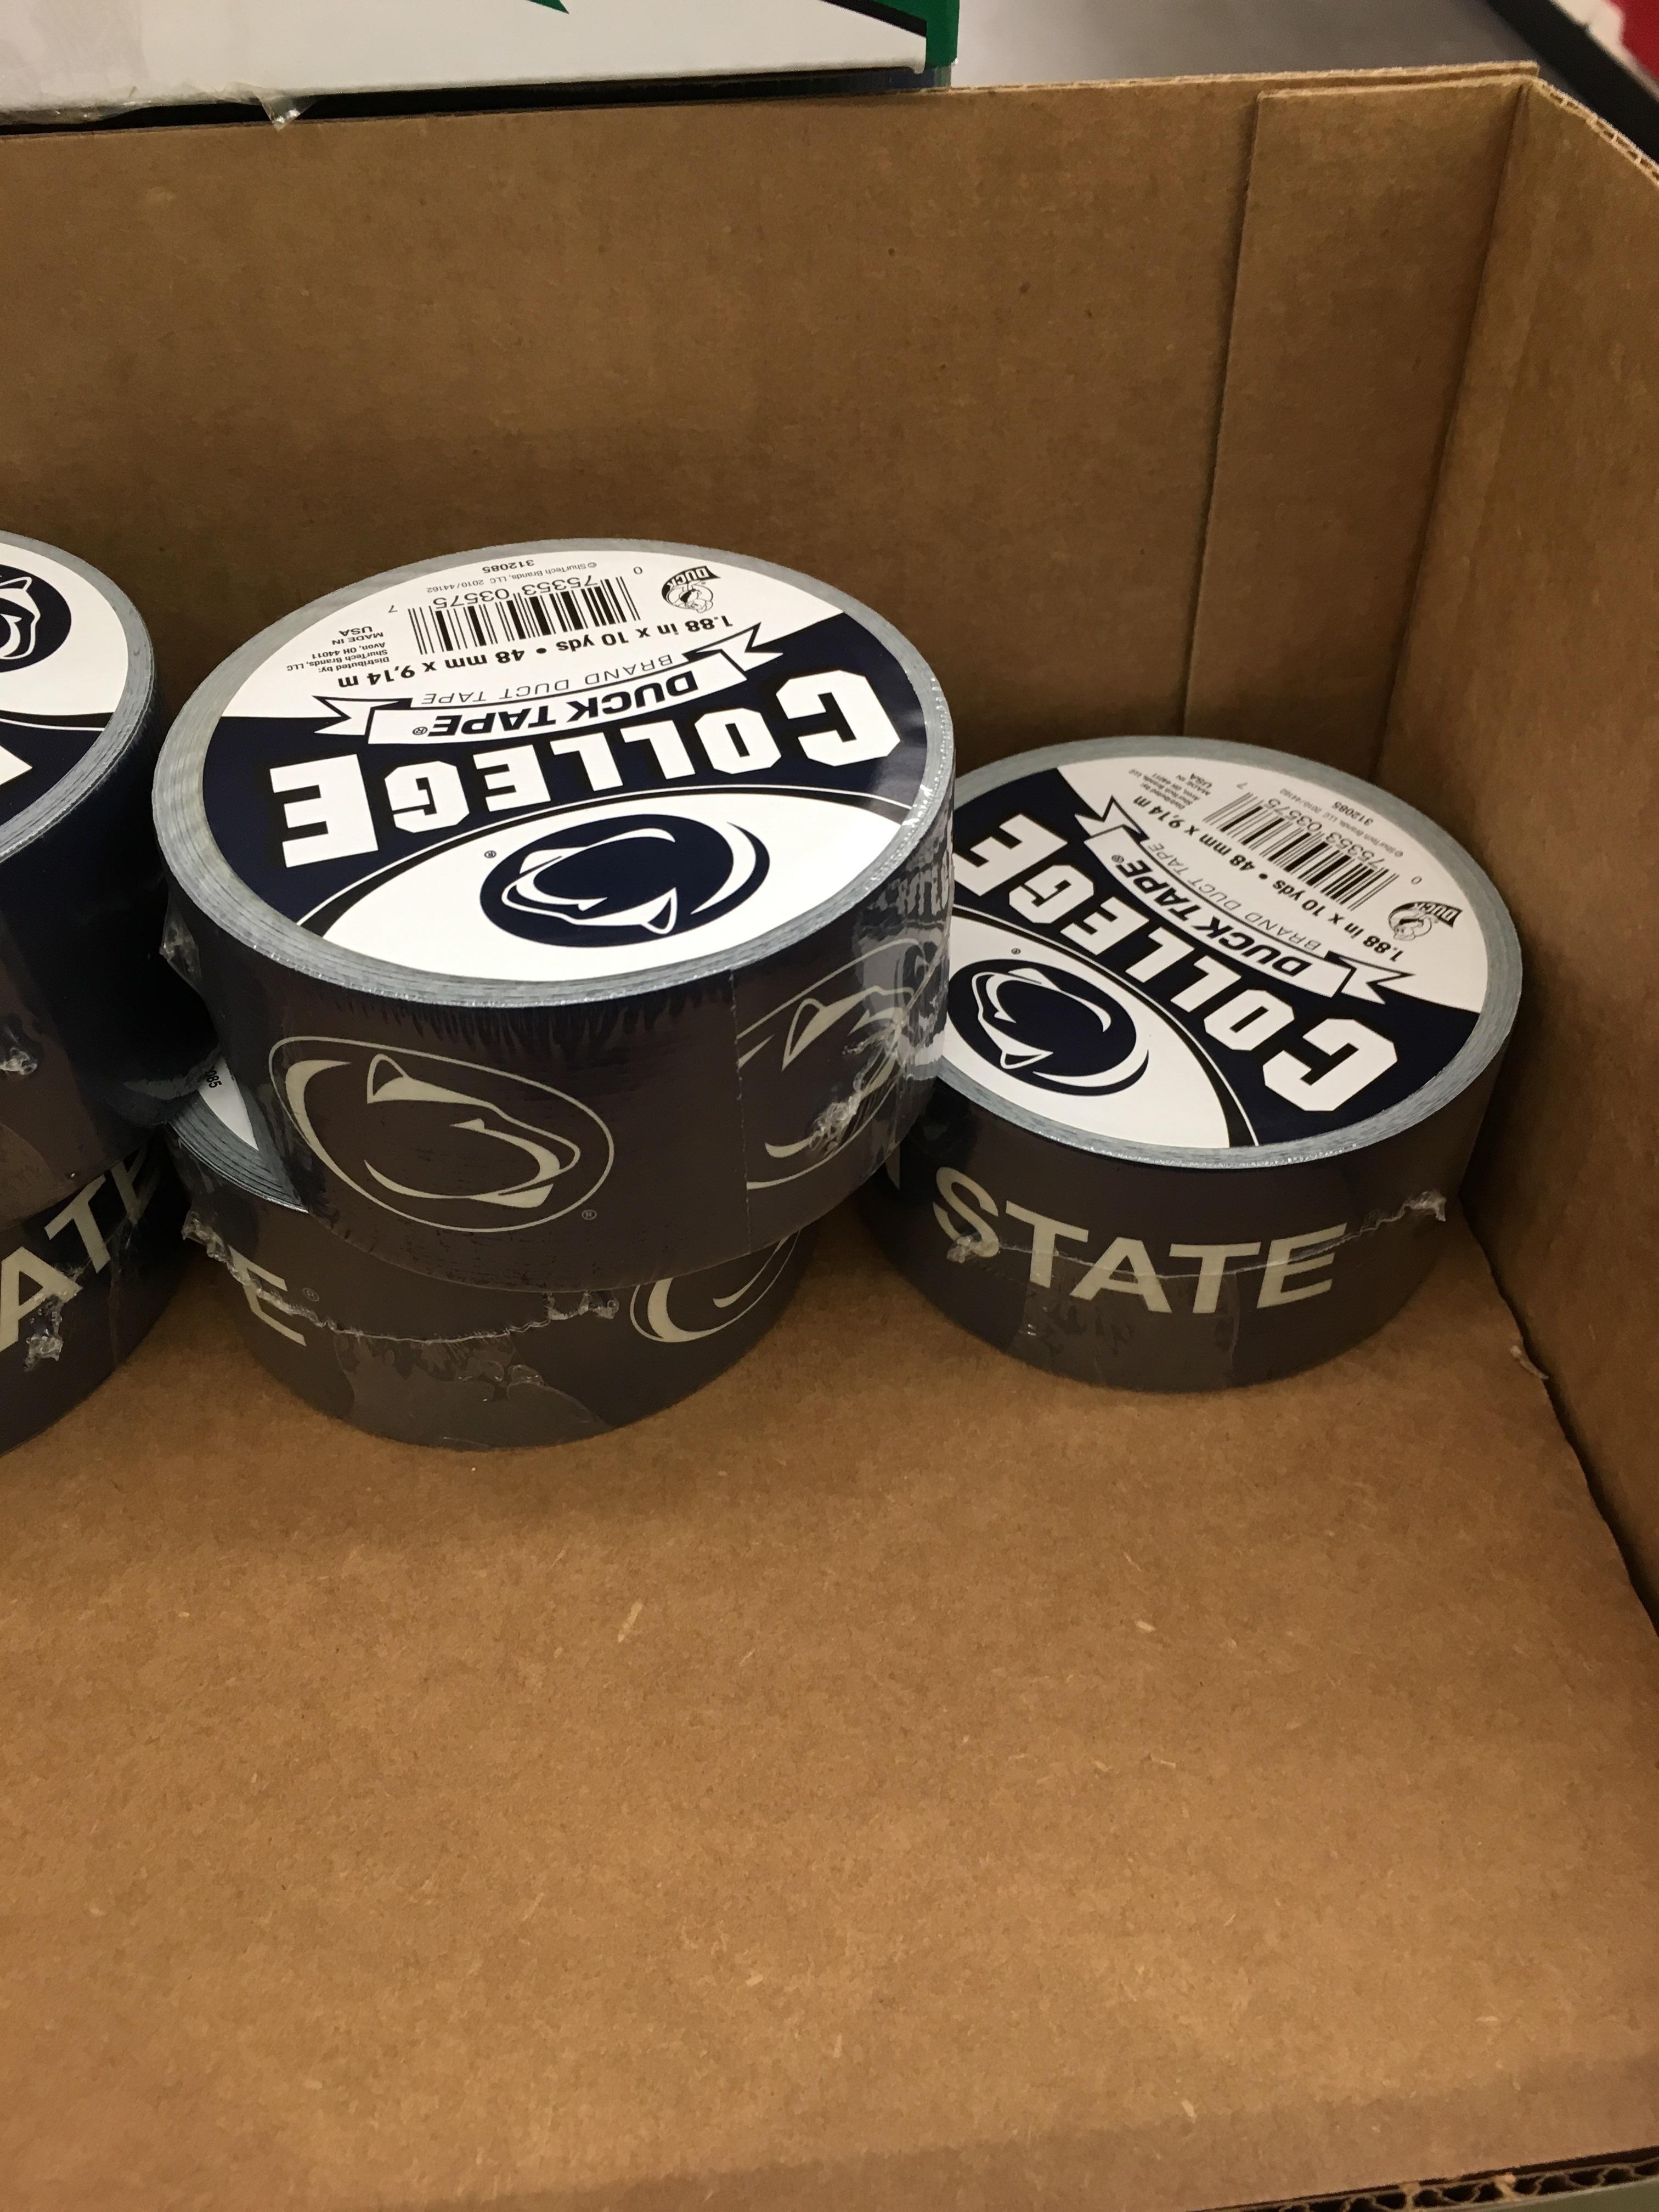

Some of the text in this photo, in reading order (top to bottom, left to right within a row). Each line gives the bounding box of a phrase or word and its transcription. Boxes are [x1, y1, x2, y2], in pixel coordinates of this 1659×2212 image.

[482, 560, 535, 573] 312085
[509, 569, 543, 580] Brands,
[667, 566, 710, 587] DUCK
[521, 575, 598, 596] 75353
[388, 605, 398, 613] 7
[433, 588, 510, 610] 03575
[338, 626, 373, 637] USA
[348, 632, 384, 643] MADE
[312, 650, 340, 659] 44011
[338, 615, 733, 688] 1.88 in x 10 yds 48 mm x 9,14 m
[358, 642, 385, 651] Avon,
[286, 649, 388, 672] ShurTech Brands, LLC
[336, 657, 390, 672] Distributed
[420, 654, 673, 705] BRAND DUCT TAPE
[566, 670, 698, 723] DUCK
[269, 669, 901, 868] COLLEGE
[1133, 795, 1152, 808] m
[1264, 798, 1323, 832] 03575
[1331, 801, 1374, 826] 312085
[1183, 825, 1200, 836] x
[1199, 833, 1232, 856] mm
[1325, 831, 1385, 870] 75353
[1229, 854, 1255, 871] 48
[1148, 842, 1322, 951] BRAND DUCT TAPE
[1272, 879, 1306, 901] yds
[1301, 898, 1326, 917] 10
[1328, 912, 1345, 924] x
[1413, 902, 1461, 921] DUCK
[1344, 921, 1365, 940] in
[1192, 916, 1313, 977] DUCK
[1363, 934, 1404, 963] 1.88
[952, 812, 1398, 1111] COLLEGE
[933, 1166, 1348, 1314] STATE
